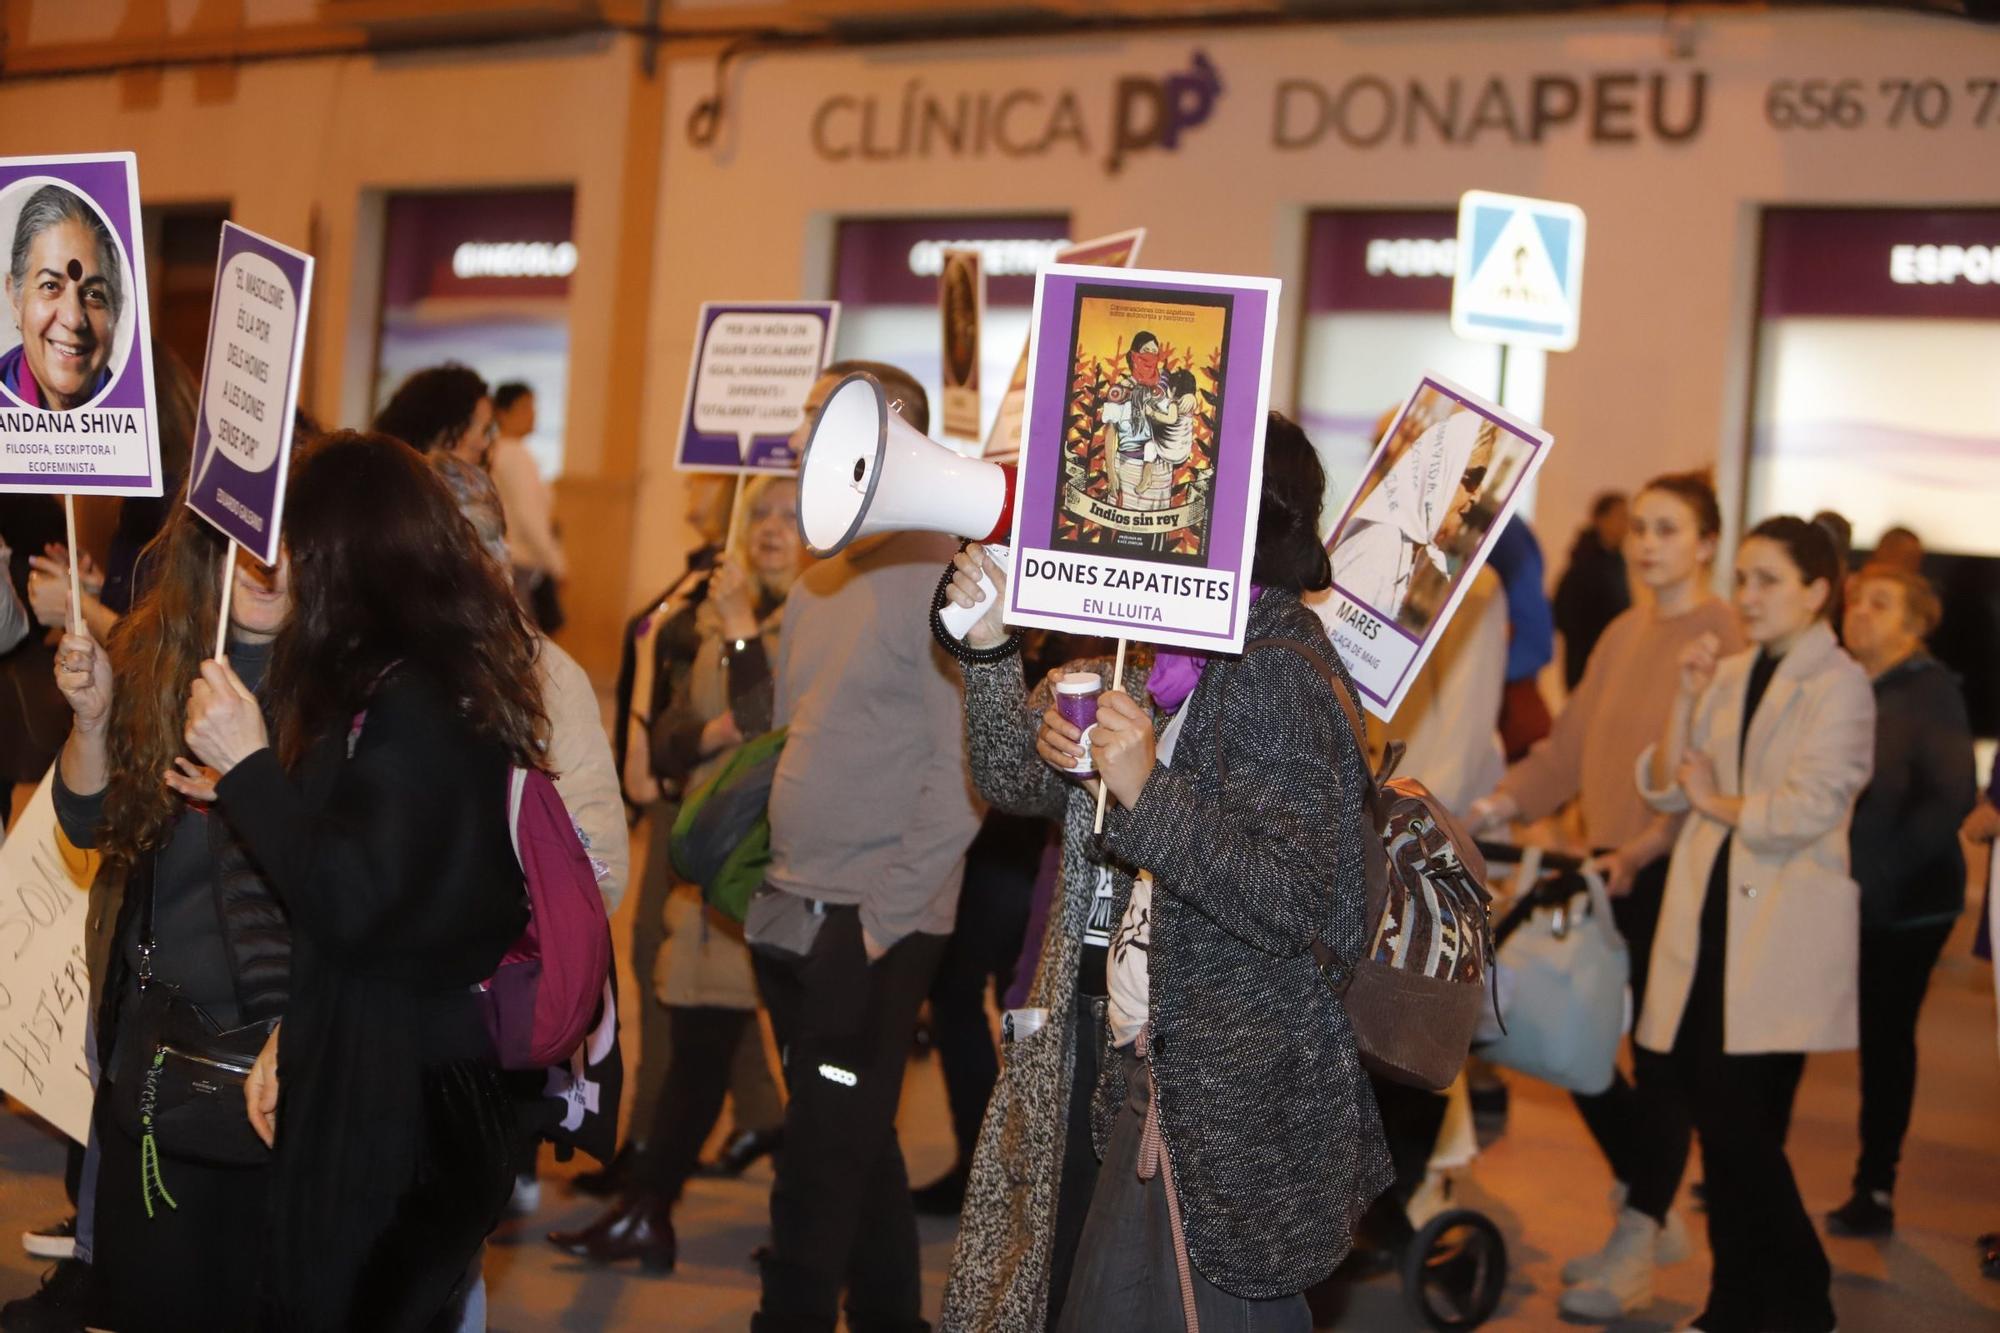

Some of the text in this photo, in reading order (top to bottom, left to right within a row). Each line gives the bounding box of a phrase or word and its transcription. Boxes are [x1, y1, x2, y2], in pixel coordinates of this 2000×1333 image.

[810, 76, 1092, 163] CLÍNICA
[1271, 70, 1710, 150] DONAPEU
[1765, 79, 1866, 131] 656
[1878, 78, 1951, 129] 70
[256, 318, 271, 343] POR
[227, 342, 269, 383] DELS HOMES
[241, 390, 265, 422] DONES
[81, 413, 137, 434] SHIVA
[218, 417, 241, 449] SENSE
[6, 443, 51, 456] FILOSOFA,
[55, 444, 111, 455] ESCRIPTORA
[29, 461, 96, 473] ECOFEMINISTA
[1089, 503, 1179, 527] Indios sin rey
[1025, 558, 1230, 602] DONES ZAPATISTES
[1083, 598, 1163, 622] EN LLUITA
[1336, 601, 1382, 640] MARES
[1351, 643, 1363, 657] DE
[1361, 650, 1381, 670] MAIG
